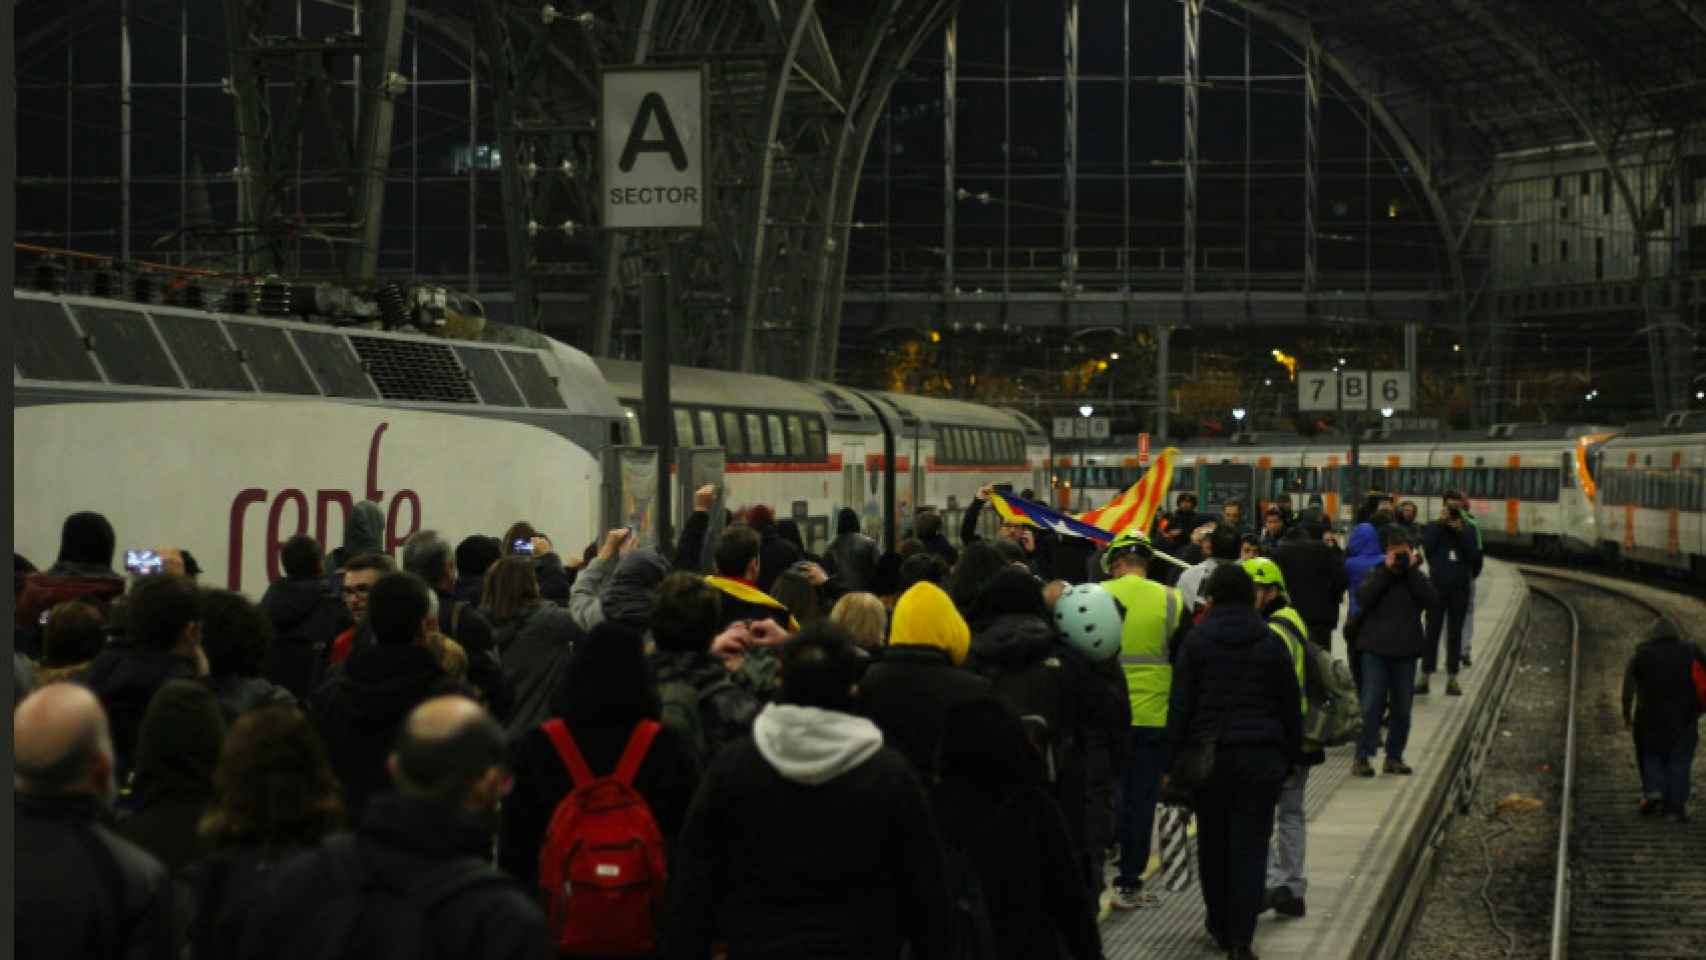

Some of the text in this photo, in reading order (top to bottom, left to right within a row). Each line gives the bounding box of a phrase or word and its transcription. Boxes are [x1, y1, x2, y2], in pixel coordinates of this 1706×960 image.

[620, 92, 688, 172] A
[610, 187, 697, 205] SECTOR
[1310, 377, 1398, 402] 7 B 6
